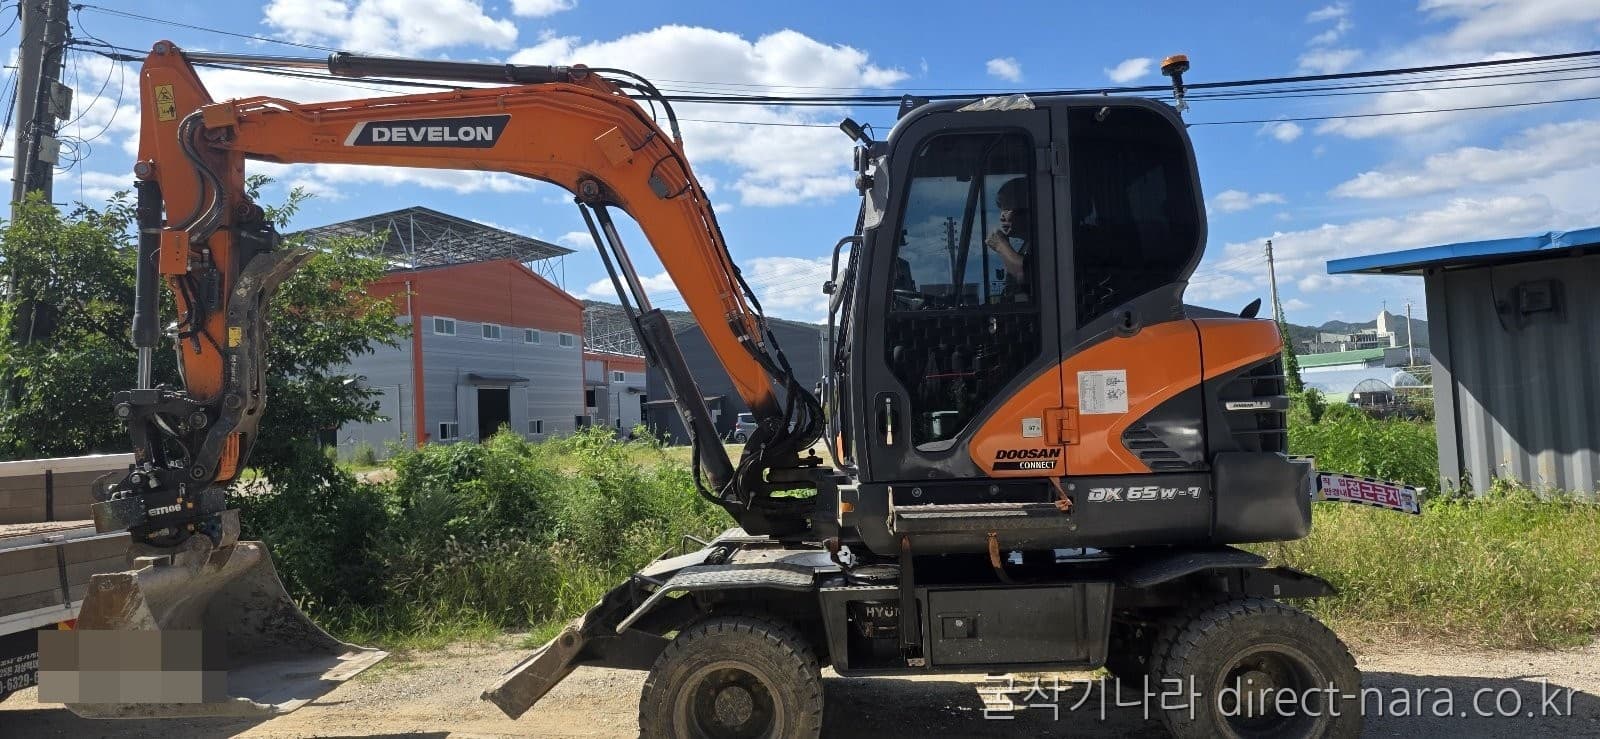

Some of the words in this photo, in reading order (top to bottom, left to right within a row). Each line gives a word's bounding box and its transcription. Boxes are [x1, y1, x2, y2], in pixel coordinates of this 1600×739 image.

[372, 126, 493, 142] DEVELON
[995, 448, 1062, 460] DOOSAN
[1019, 461, 1055, 469] CONNECT
[1088, 487, 1123, 502] DX
[1347, 480, 1400, 507] 접근금지
